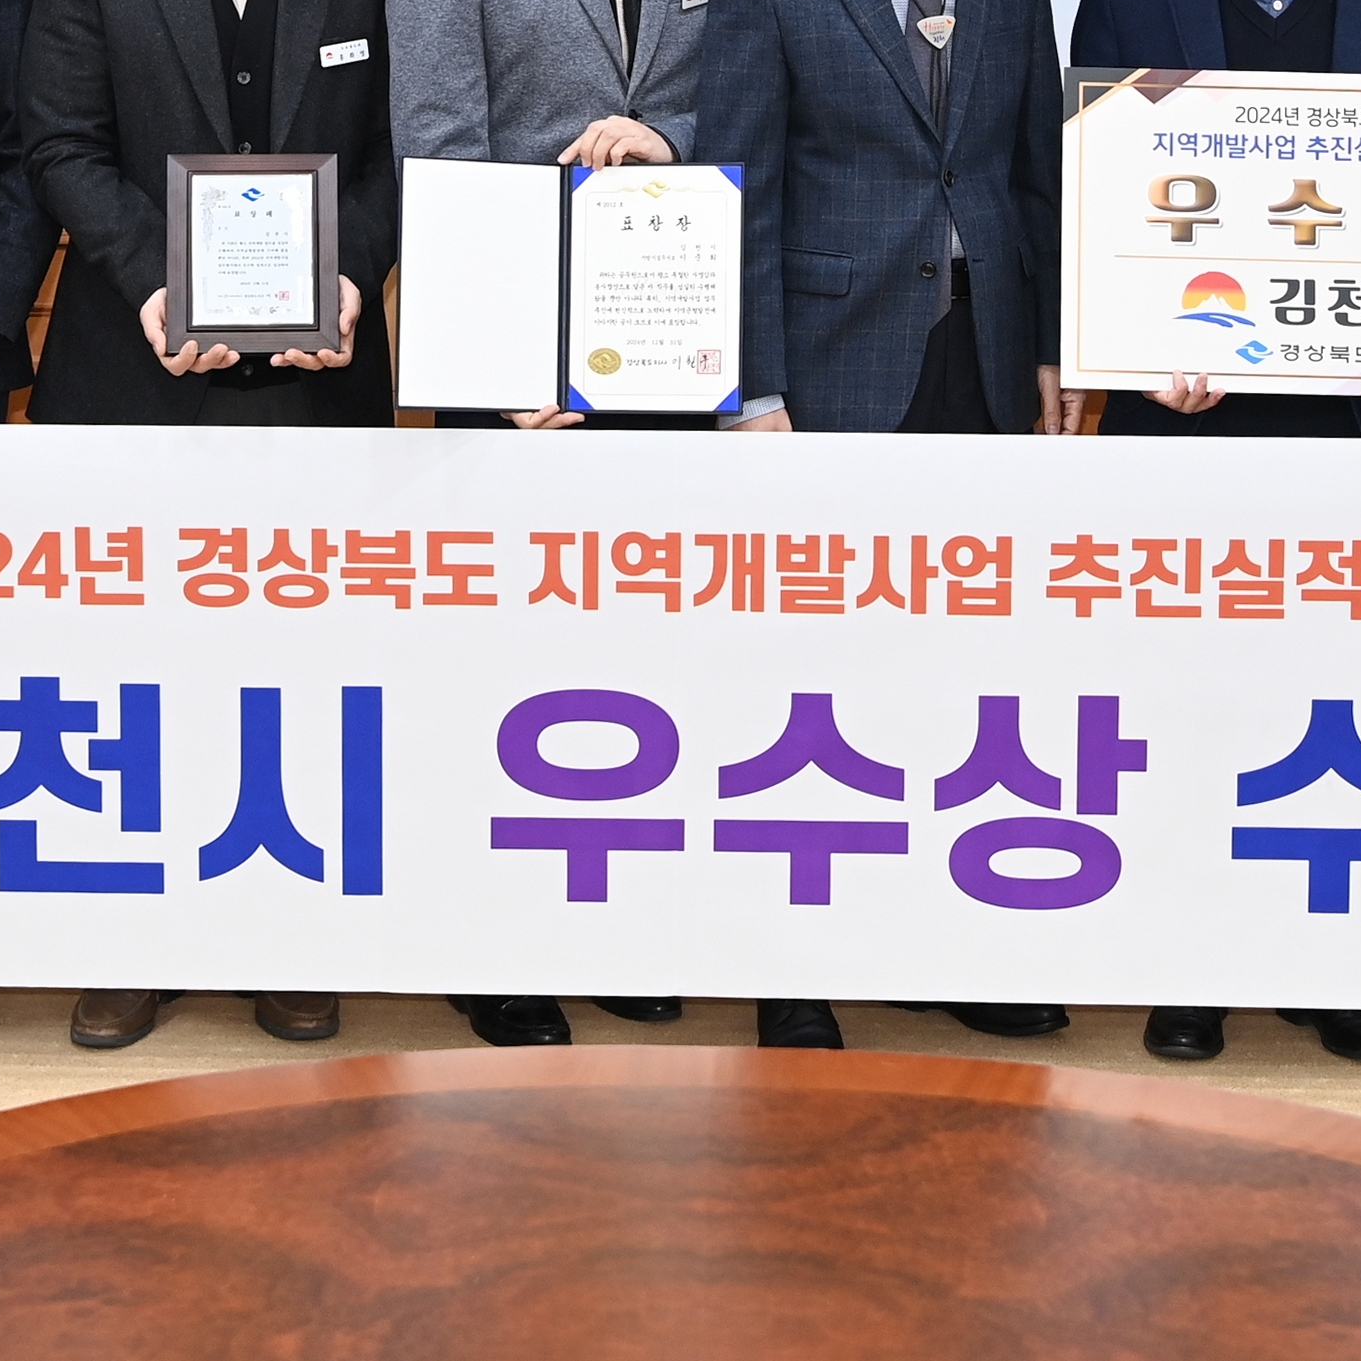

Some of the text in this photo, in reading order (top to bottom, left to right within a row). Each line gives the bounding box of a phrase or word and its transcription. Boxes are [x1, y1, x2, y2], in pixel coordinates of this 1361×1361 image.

[1152, 131, 1296, 161] 지역개발사업
[1234, 106, 1300, 127] 2024년
[178, 528, 500, 612] 경상북도
[529, 532, 1015, 618] 지역개발사업
[492, 691, 1148, 910] 우수상
